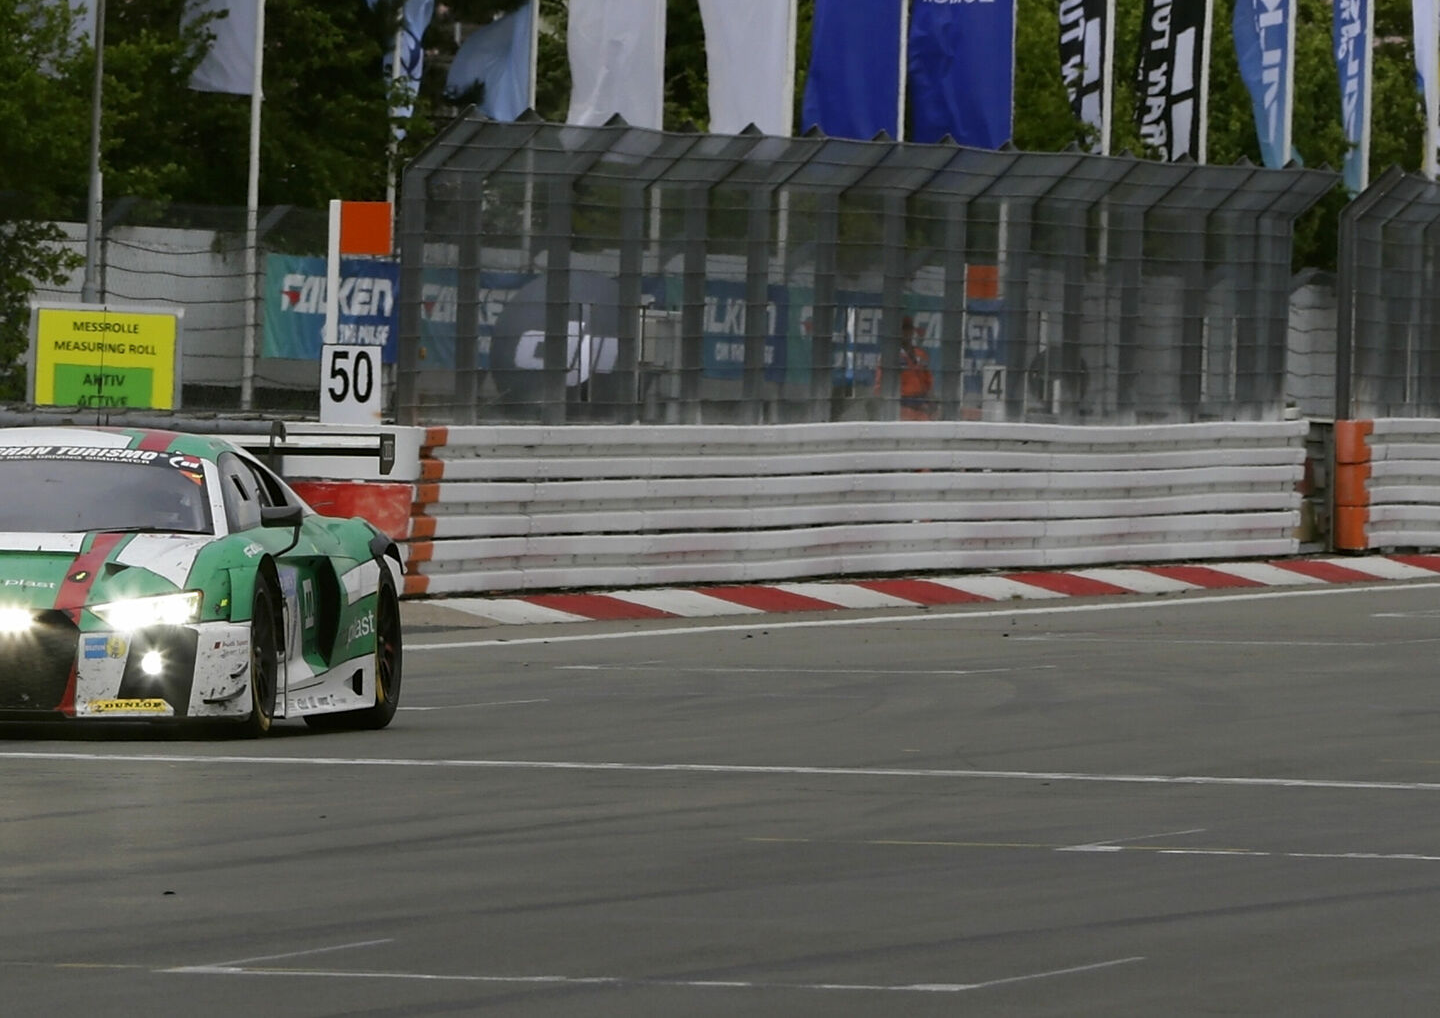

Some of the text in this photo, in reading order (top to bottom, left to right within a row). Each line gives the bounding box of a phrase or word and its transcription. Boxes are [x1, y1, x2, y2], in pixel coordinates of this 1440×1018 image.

[72, 320, 140, 335] MESSROLLE
[53, 340, 157, 356] MEASURING ROLL
[327, 349, 374, 404] 50
[55, 446, 159, 461] TURISMO
[104, 700, 163, 710] DUNLOP
